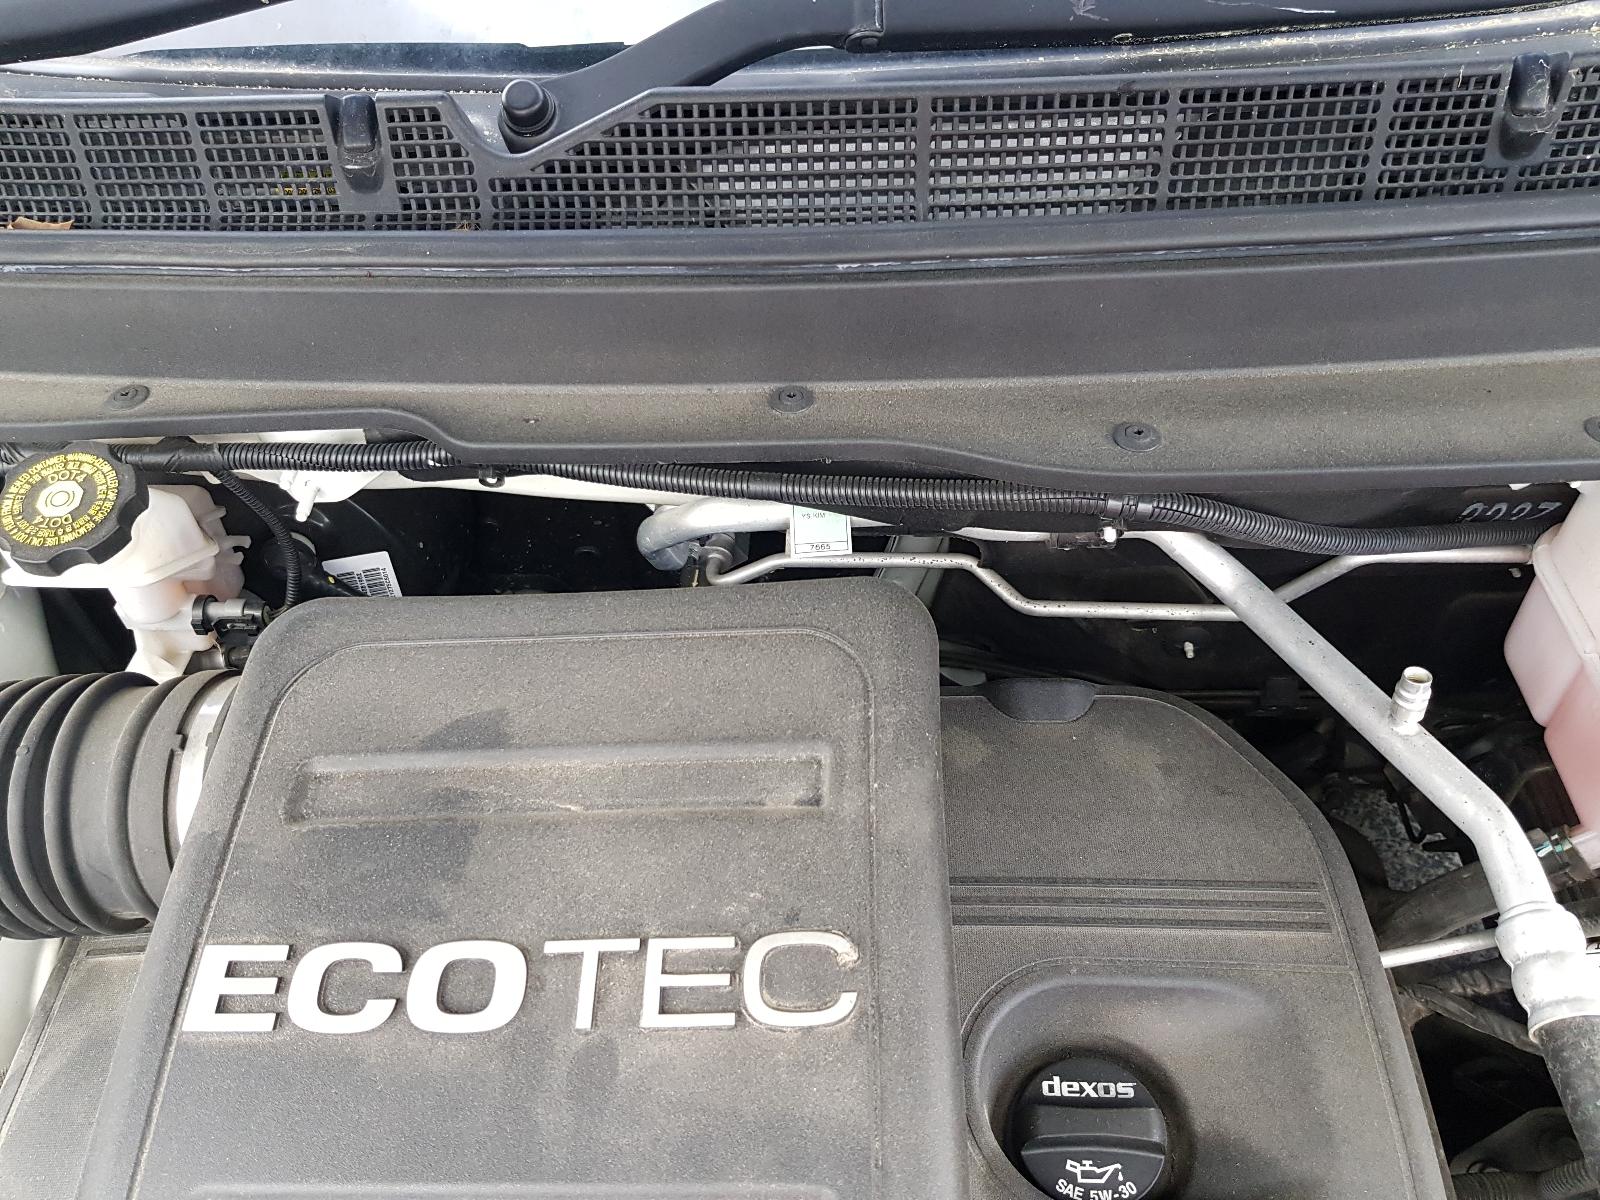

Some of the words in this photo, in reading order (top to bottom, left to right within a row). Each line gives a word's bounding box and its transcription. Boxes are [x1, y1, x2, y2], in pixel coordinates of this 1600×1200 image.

[27, 454, 64, 475] CONTAINER
[92, 501, 114, 523] BEFORE
[60, 521, 96, 543] REMOVING
[180, 931, 859, 1034] ECOTEC
[1041, 1075, 1137, 1099] dexos
[1055, 1178, 1085, 1200] SAE
[1089, 1181, 1138, 1200] 5W-30
